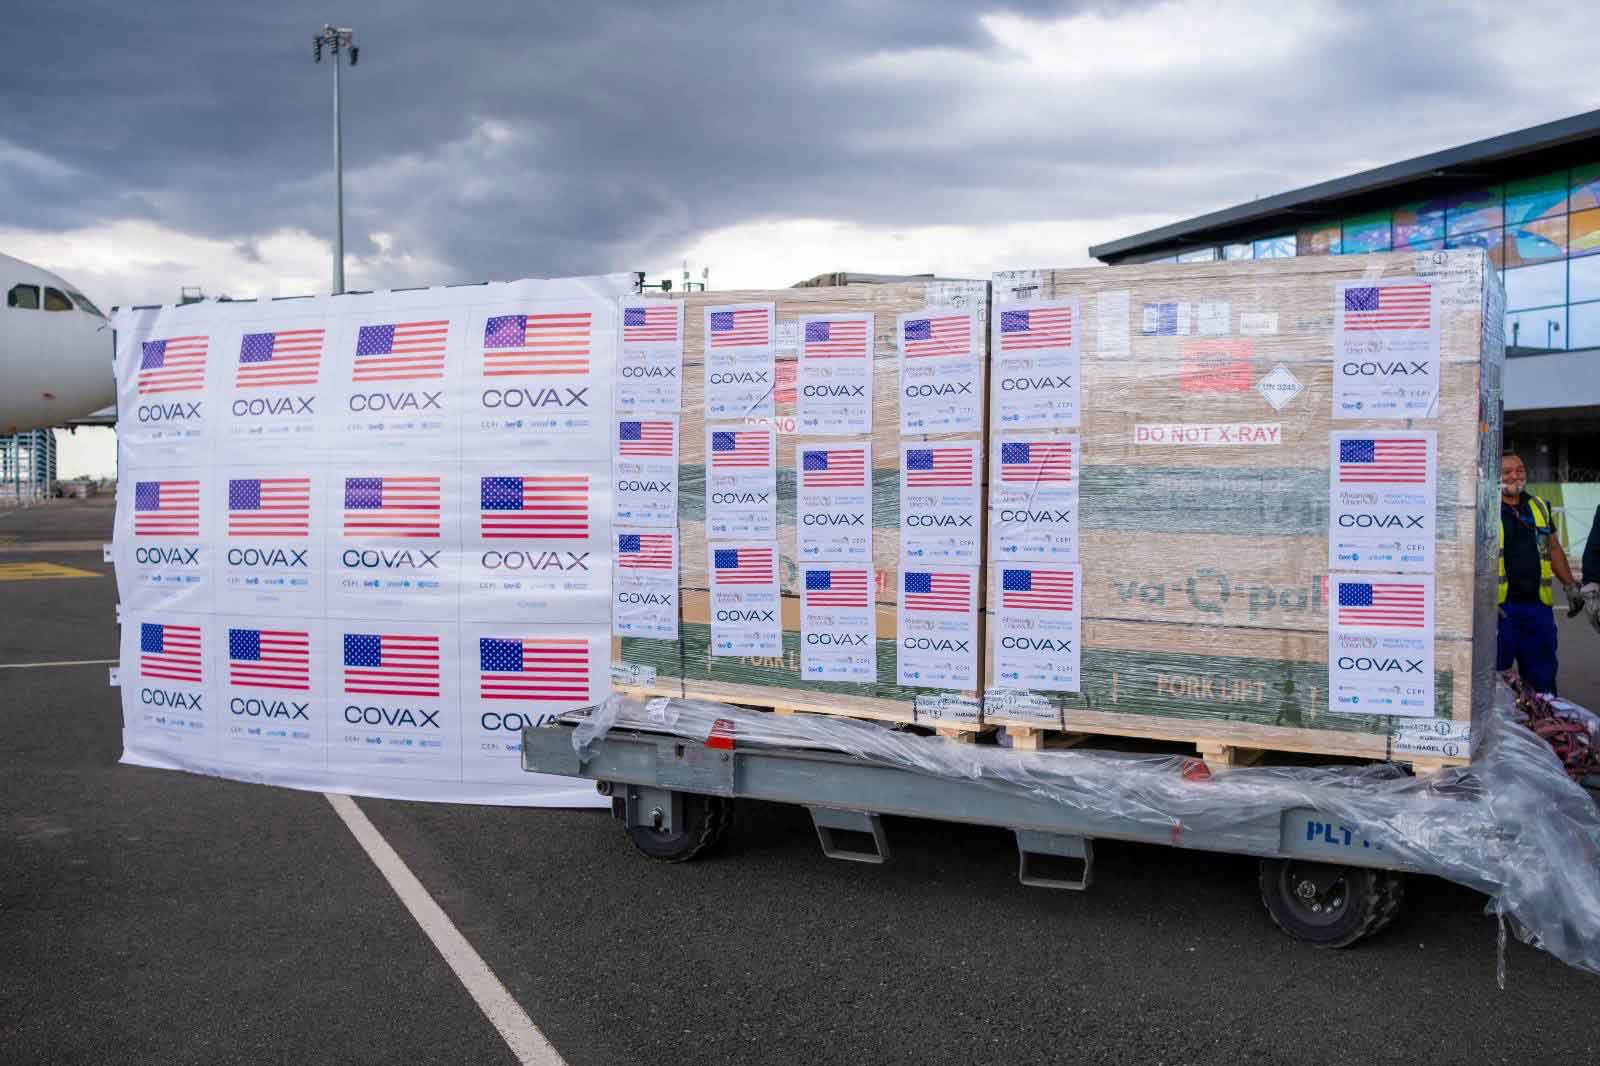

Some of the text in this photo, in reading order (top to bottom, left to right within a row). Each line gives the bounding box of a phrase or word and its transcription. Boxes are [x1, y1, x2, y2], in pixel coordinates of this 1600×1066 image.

[623, 367, 675, 377] COVAX
[1343, 362, 1428, 375] COVAX
[711, 372, 767, 384] COVAX
[1001, 376, 1071, 391] COVAX
[804, 385, 864, 396] COVAX
[906, 382, 972, 397] COVAX
[350, 392, 442, 411] COVAX
[483, 388, 588, 407] COVAX
[138, 402, 200, 422] COVAX
[232, 397, 315, 416] COVAX
[776, 416, 796, 432] NO
[1137, 427, 1279, 442] DO NOT X-RAY
[619, 481, 671, 492] COVAX
[712, 493, 768, 504] COVAX
[804, 514, 864, 525] COVAX
[907, 515, 972, 526] COVAX
[1001, 510, 1070, 522] COVAX
[1339, 515, 1424, 528] COVAX
[136, 548, 198, 564] COVAX
[228, 549, 307, 566] COVAX
[343, 550, 440, 568] COVAX
[482, 551, 589, 570] COVAX
[619, 593, 671, 605] COVAX
[717, 610, 774, 621] COVAX
[807, 634, 868, 645] COVAX
[904, 638, 968, 652] COVAX
[1002, 637, 1071, 652] COVAX
[1338, 657, 1423, 673] COVAX
[142, 688, 202, 710] COVAX
[231, 698, 309, 720] COVAX
[345, 706, 440, 728] COVAX
[482, 713, 557, 731] COV
